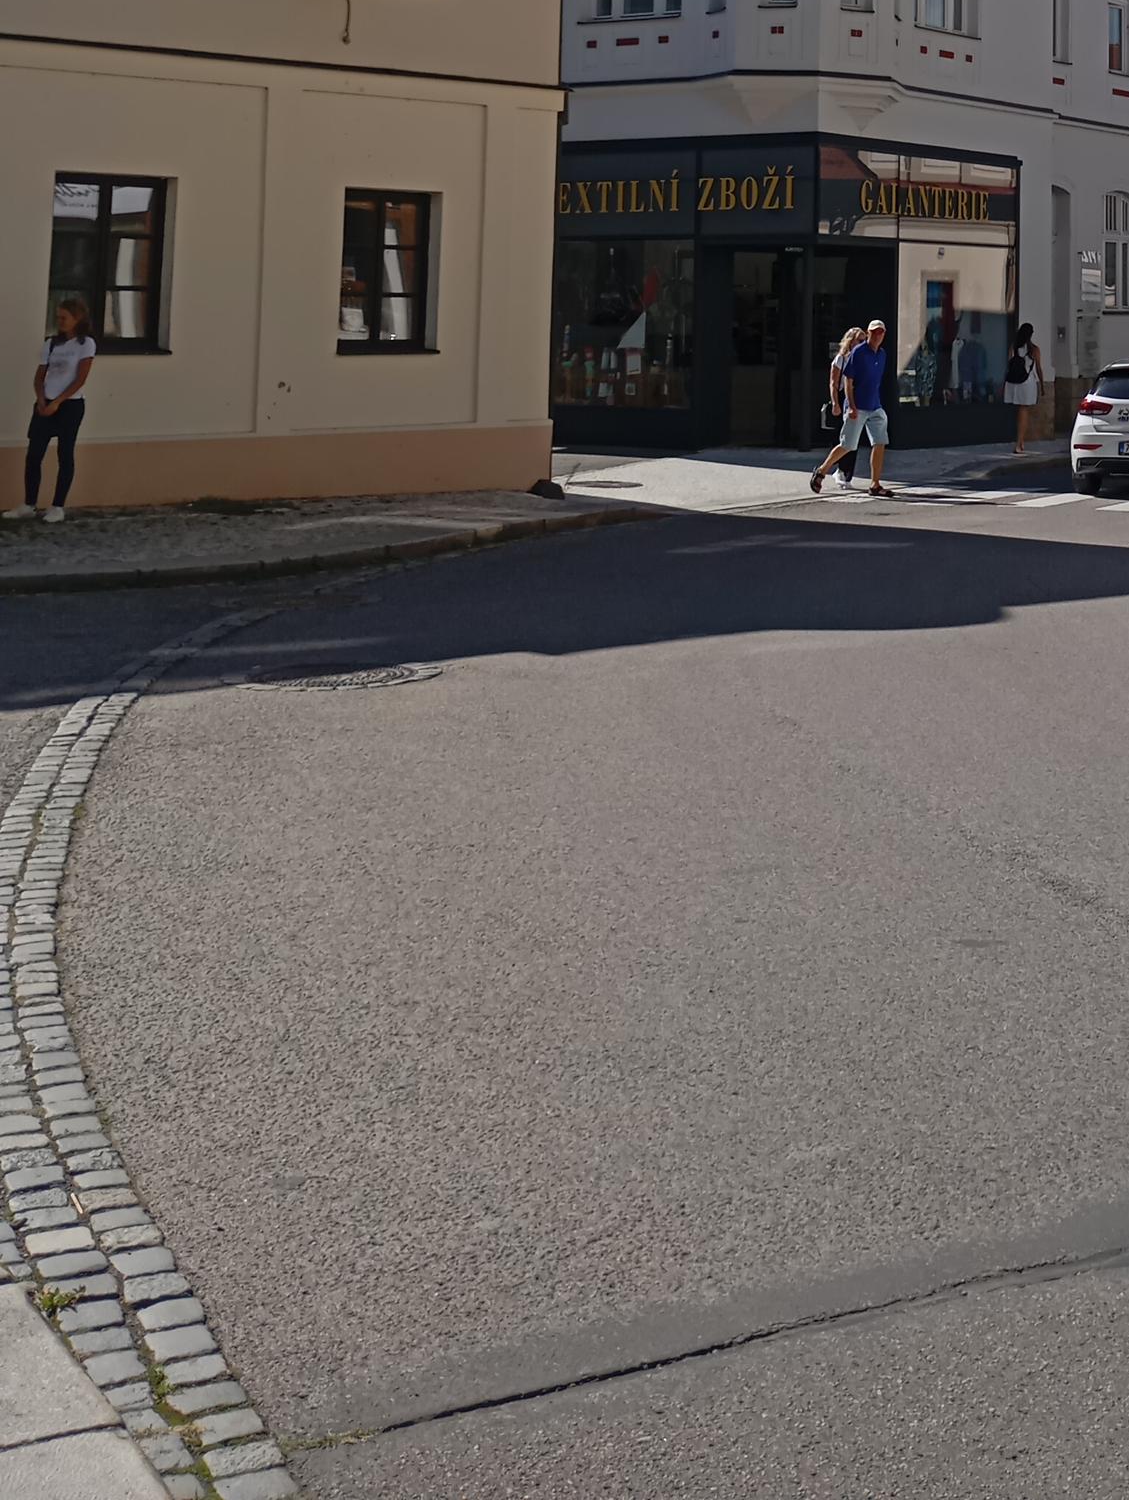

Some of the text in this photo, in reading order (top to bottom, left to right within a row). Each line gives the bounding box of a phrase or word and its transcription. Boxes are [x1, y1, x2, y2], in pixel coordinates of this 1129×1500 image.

[559, 165, 795, 214] EXTILNÍ ZBOŽÍ
[860, 179, 990, 221] GALANTERIE
